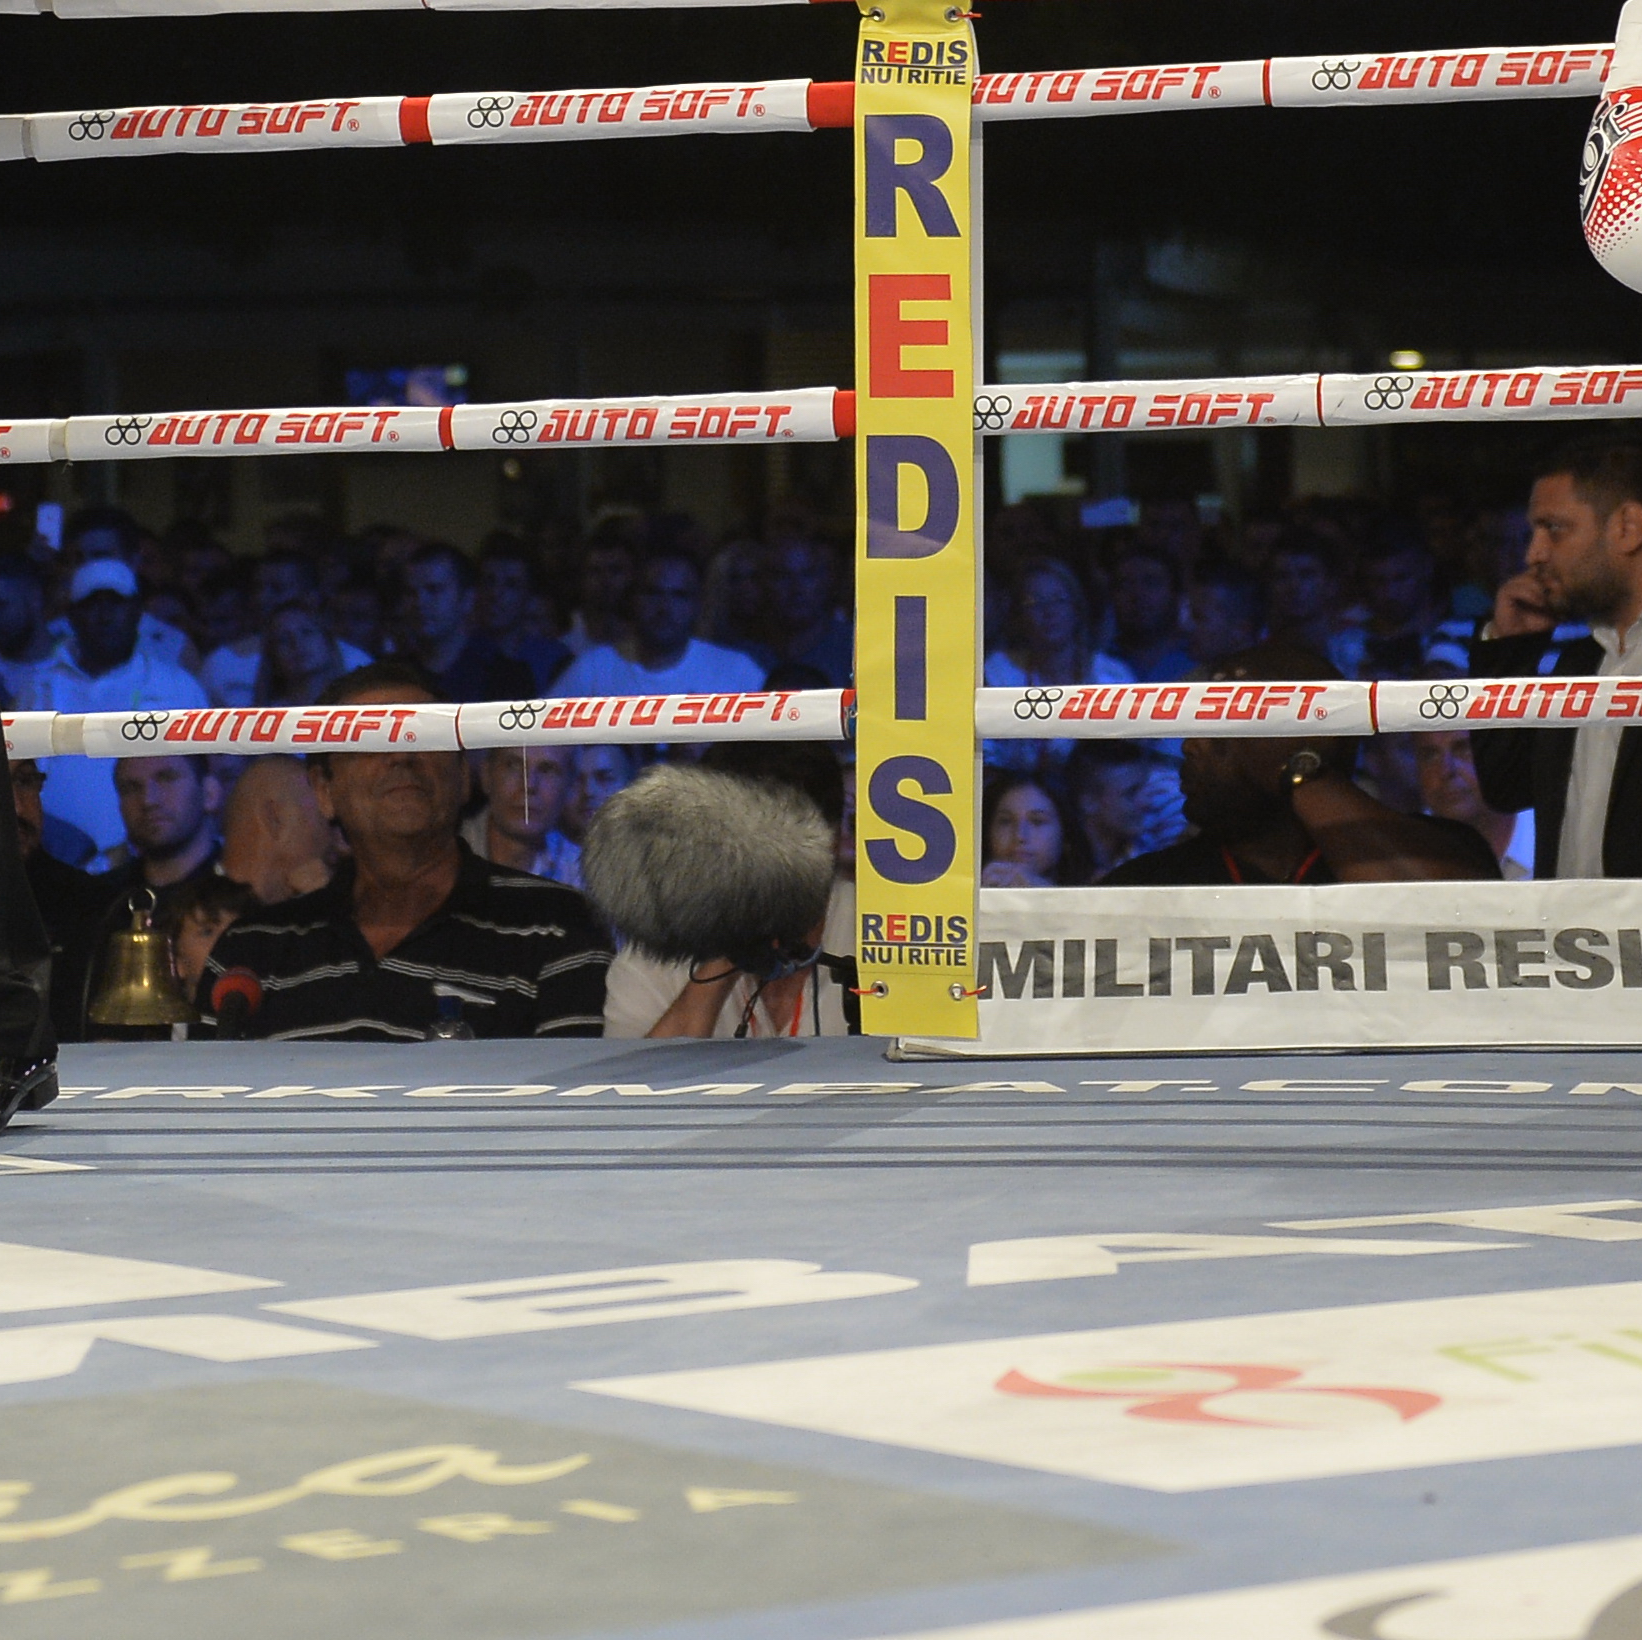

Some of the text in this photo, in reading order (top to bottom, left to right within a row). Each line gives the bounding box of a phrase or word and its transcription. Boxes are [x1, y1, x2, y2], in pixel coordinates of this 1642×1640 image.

[862, 39, 968, 63] REDIS
[861, 64, 966, 85] NUTRITIE
[862, 112, 962, 886] REDIS
[861, 913, 968, 943] REDIS
[861, 944, 967, 967] NUTRITIE
[979, 930, 1390, 1001] MILITARI
